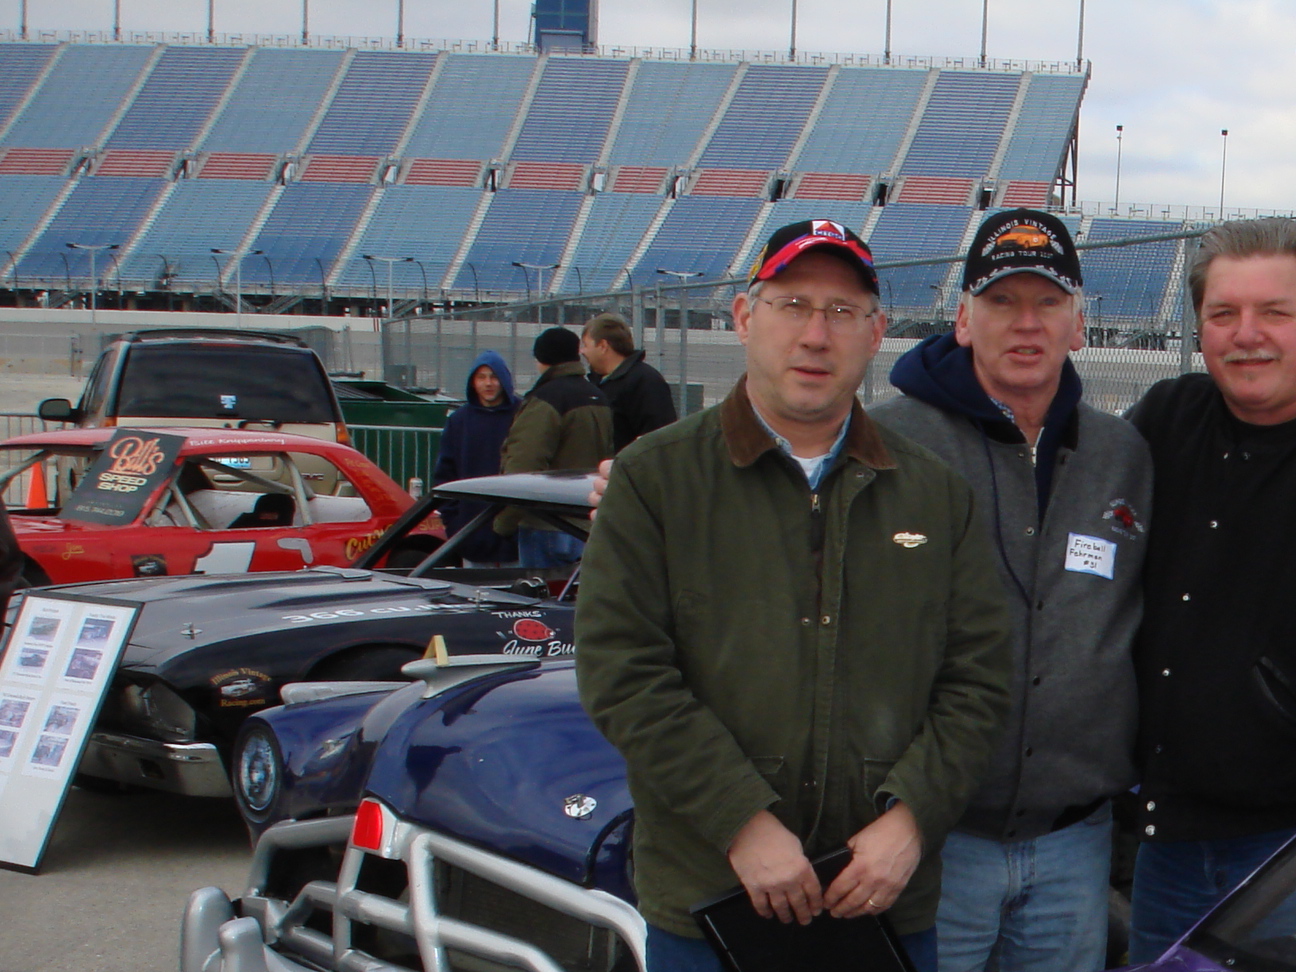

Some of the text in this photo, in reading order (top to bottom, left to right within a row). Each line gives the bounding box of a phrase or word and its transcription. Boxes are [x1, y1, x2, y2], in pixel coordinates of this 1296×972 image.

[988, 218, 1058, 243] ILLINOIS VINTAGE
[99, 472, 148, 486] SPEED
[97, 482, 139, 494] SHOP
[1074, 539, 1106, 552] Fireball
[282, 608, 365, 624] 366
[491, 610, 542, 620] THANKS
[503, 639, 575, 657] June Bu
